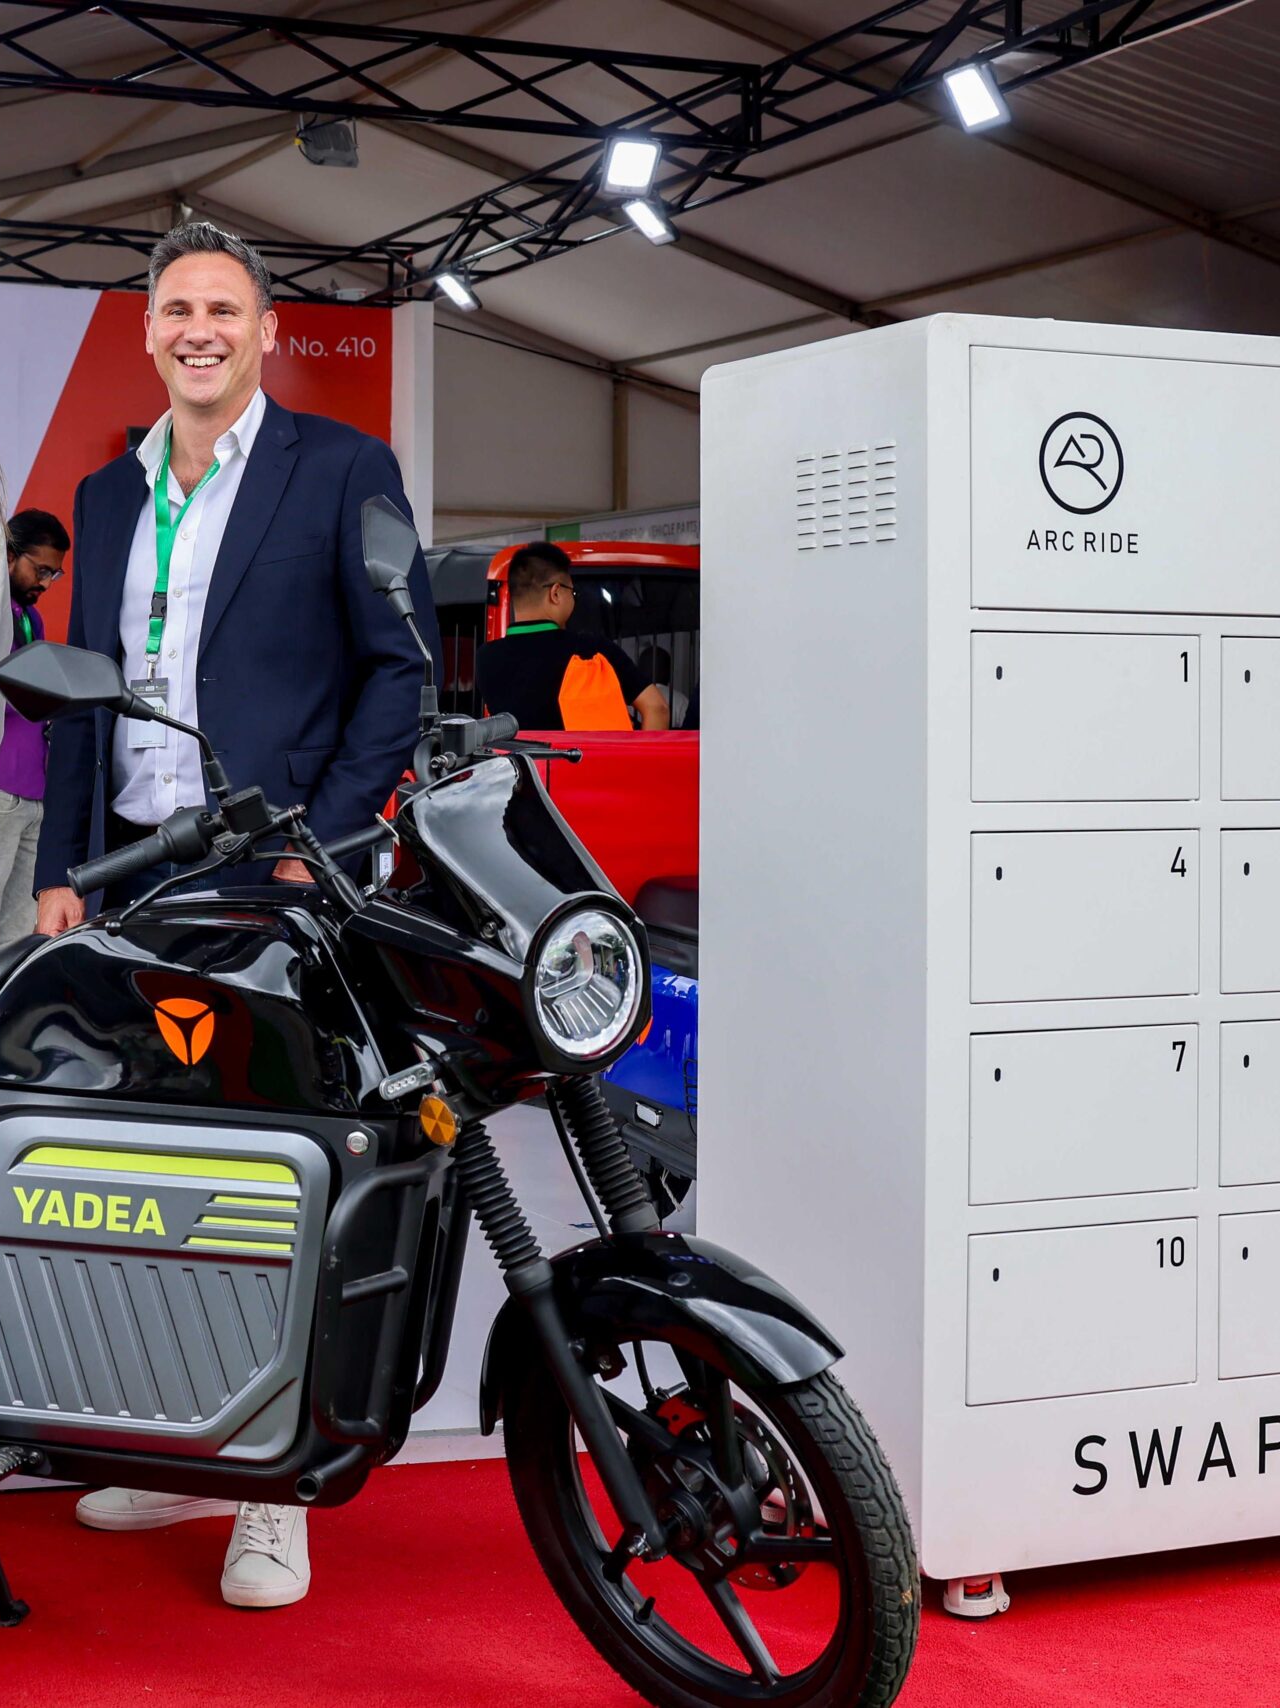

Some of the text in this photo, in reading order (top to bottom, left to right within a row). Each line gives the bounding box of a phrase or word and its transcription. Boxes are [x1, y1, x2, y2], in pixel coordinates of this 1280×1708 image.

[290, 336, 328, 356] No.
[336, 337, 376, 357] 410
[1026, 529, 1140, 554] ARC RIDE
[1180, 651, 1188, 683] 1
[1170, 845, 1187, 878] 4
[1171, 1040, 1187, 1073] 7
[12, 1186, 166, 1236] YADEA
[1155, 1235, 1186, 1269] 10
